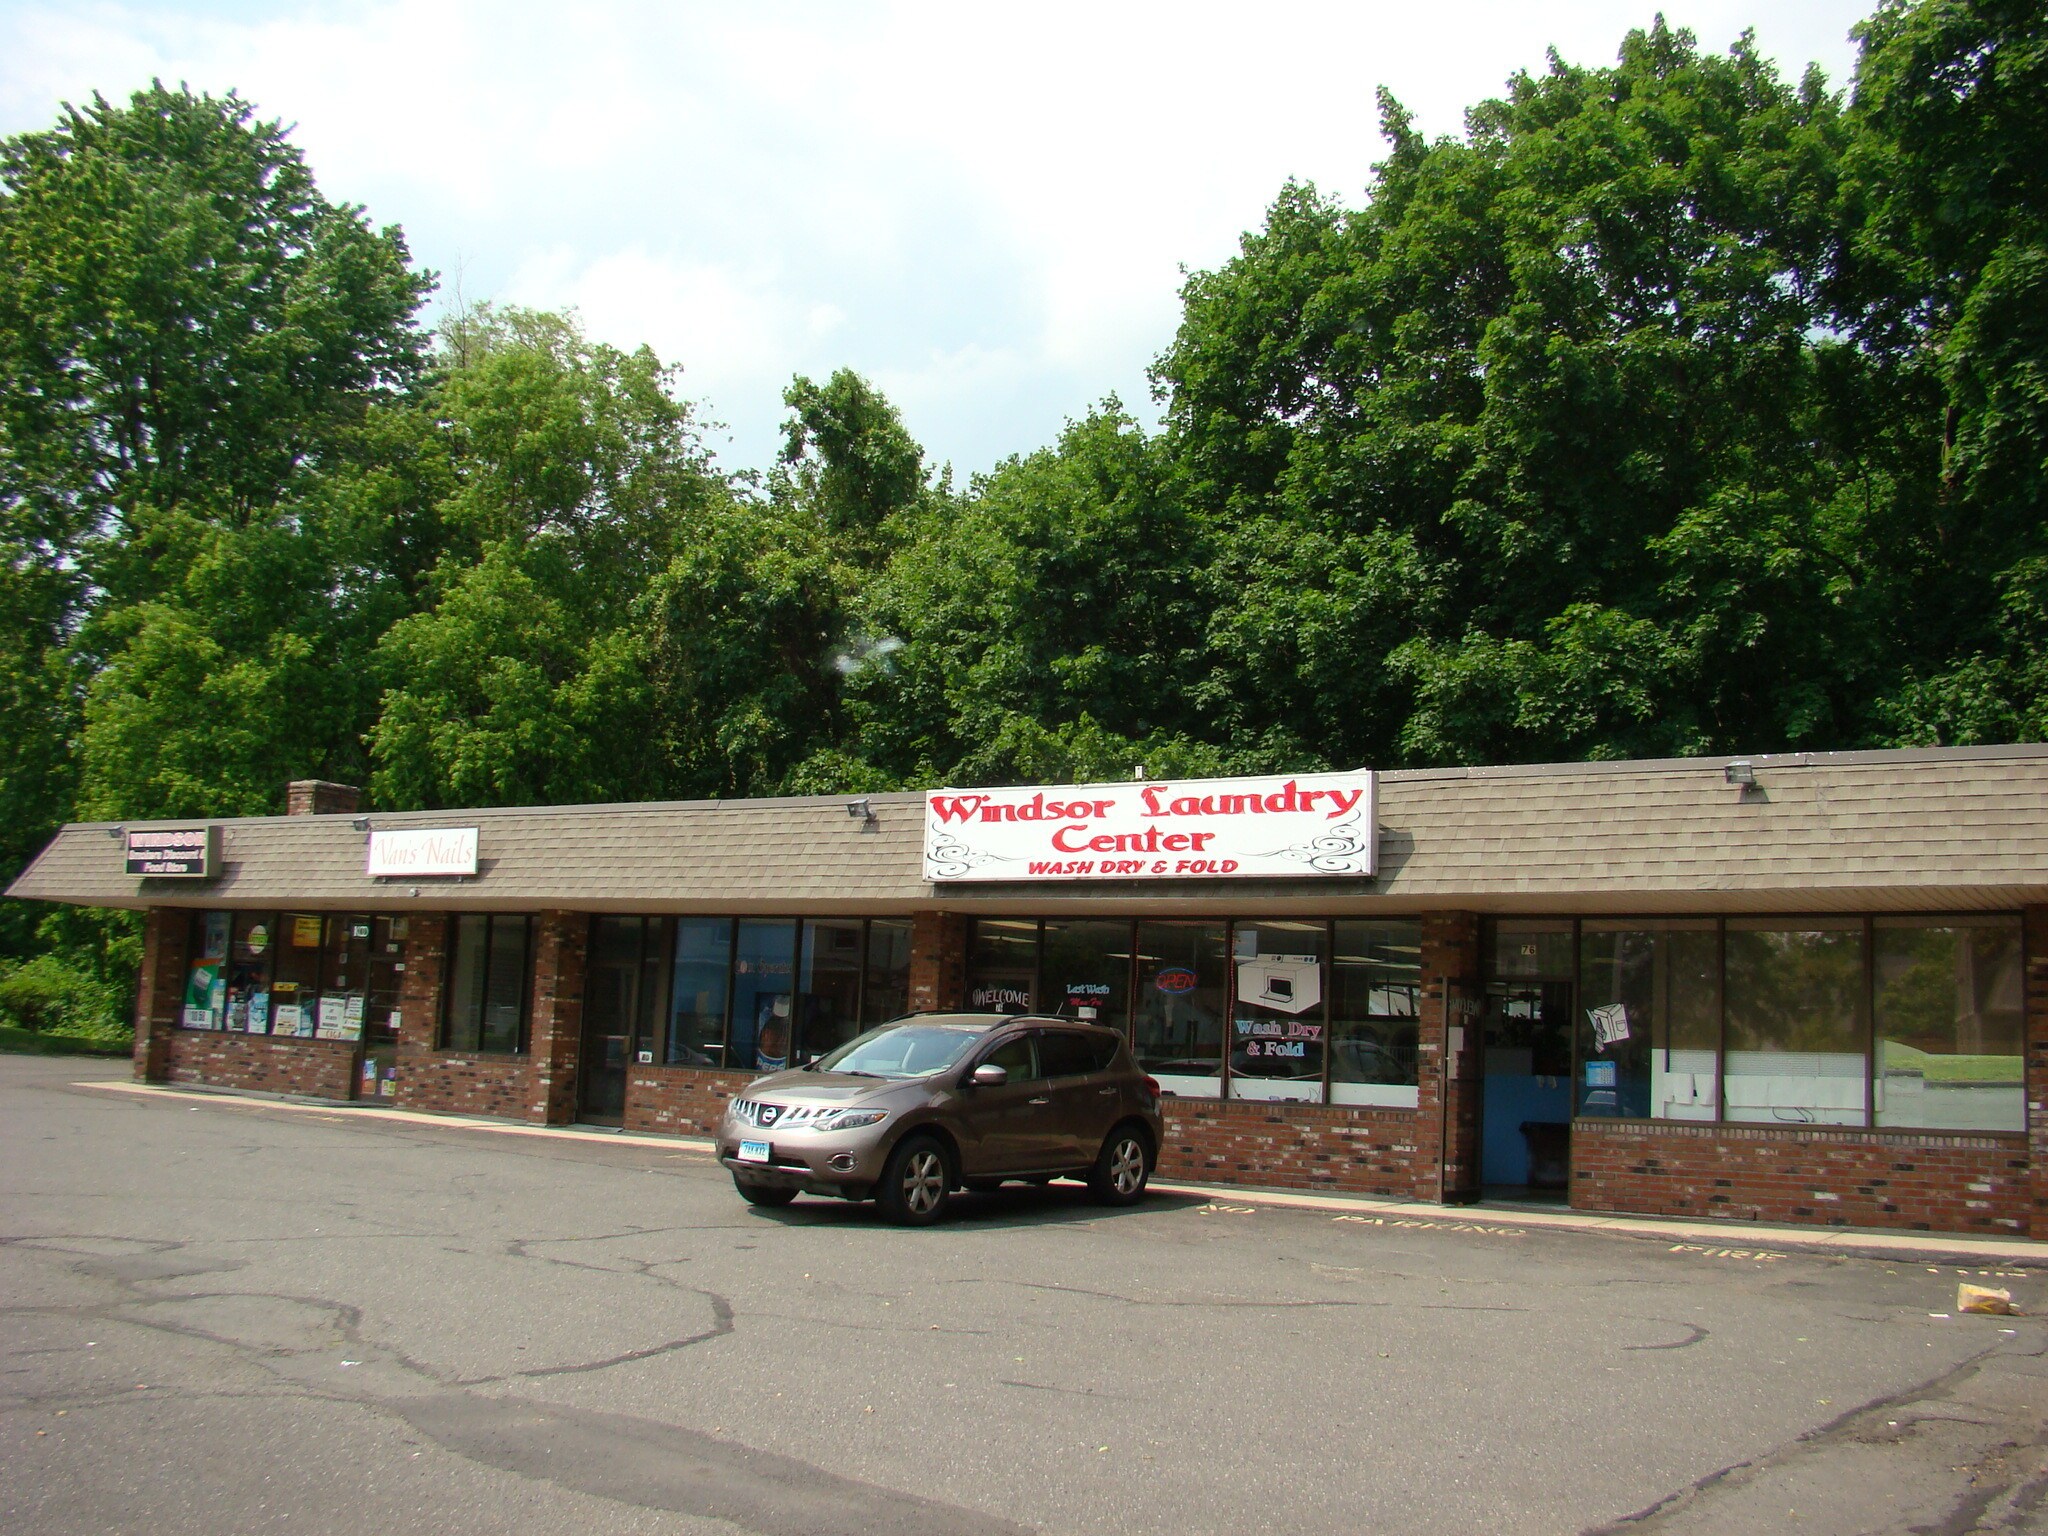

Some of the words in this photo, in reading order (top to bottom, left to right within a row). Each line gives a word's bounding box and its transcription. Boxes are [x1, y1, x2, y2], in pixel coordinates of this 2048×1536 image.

[930, 792, 1116, 825] Windsor
[1140, 779, 1364, 820] Laundry
[1051, 824, 1216, 854] Center
[421, 834, 473, 865] Nails
[1028, 860, 1095, 875] WASH
[1100, 860, 1146, 875] DRY
[1151, 860, 1167, 874] &
[1175, 859, 1239, 874] FOLD
[1521, 944, 1536, 955] 76
[1066, 983, 1085, 994] Last
[1085, 983, 1110, 994] Wash
[1156, 973, 1197, 989] OPEN
[1235, 1020, 1282, 1036] Wash
[1287, 1021, 1322, 1039] Dry
[1246, 1041, 1260, 1056] &
[1264, 1041, 1305, 1057] Fold
